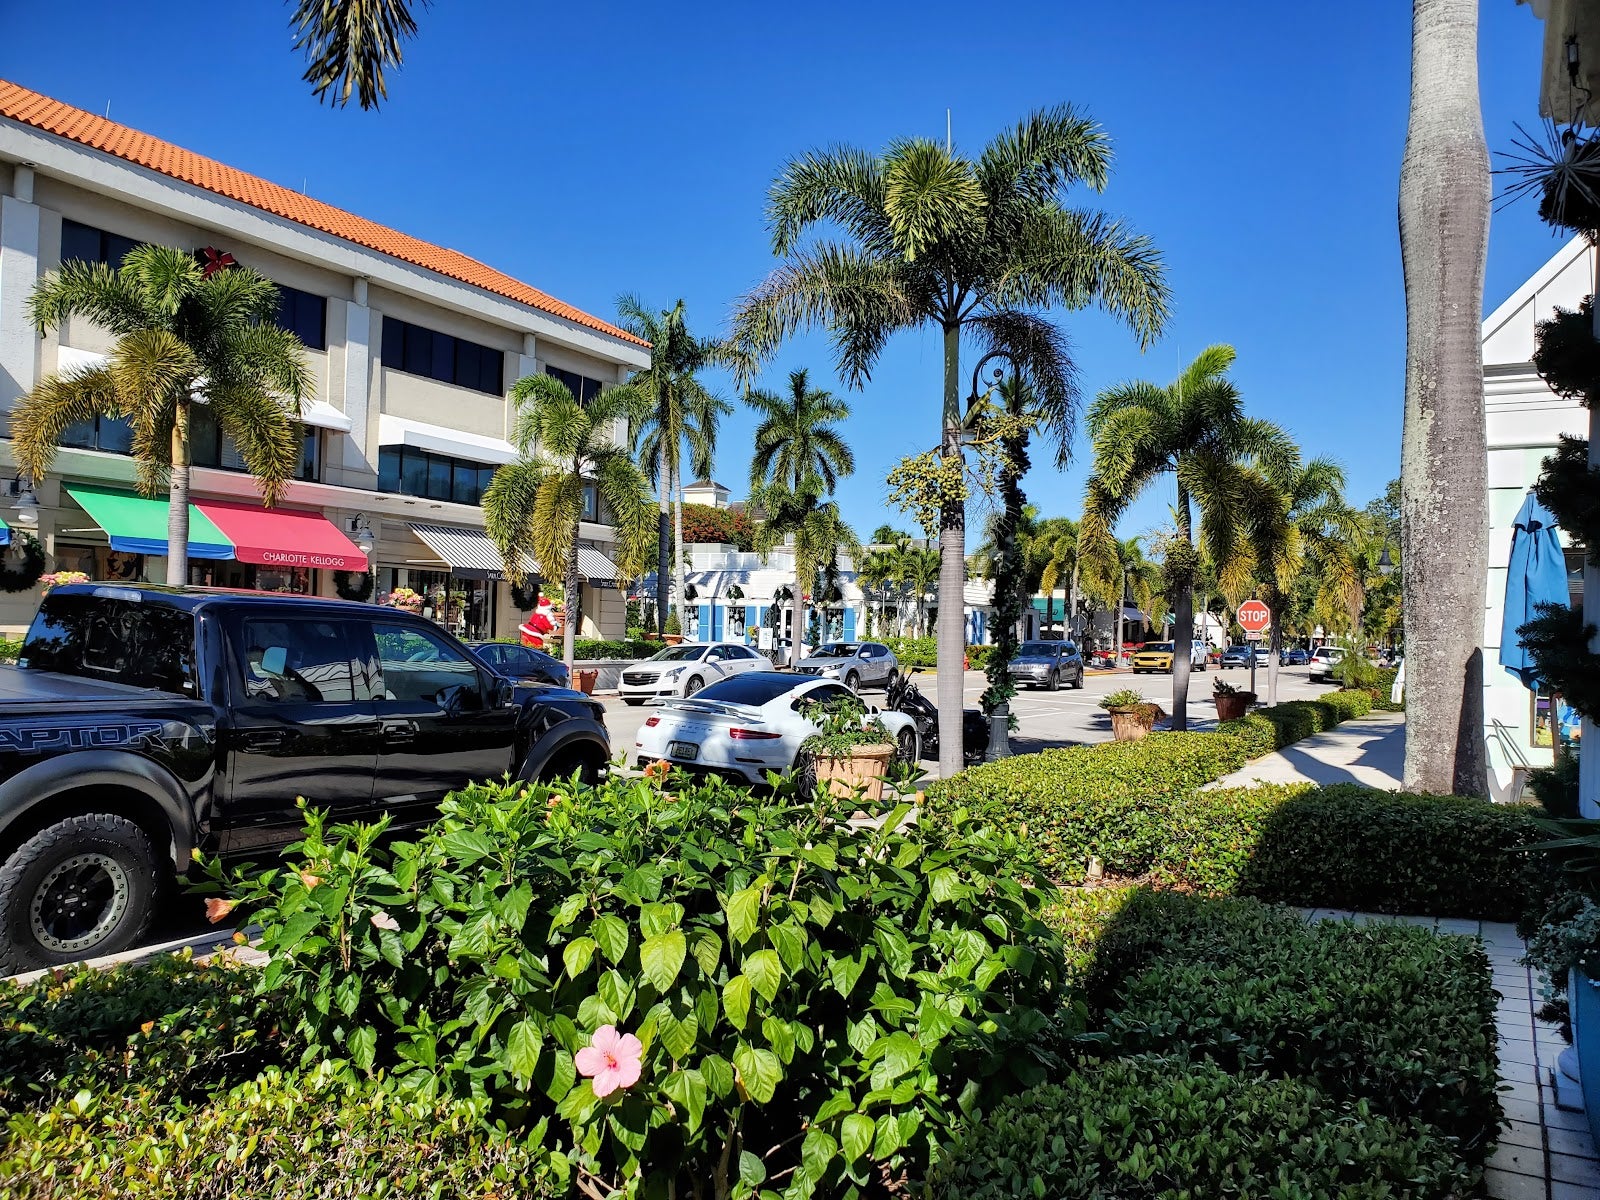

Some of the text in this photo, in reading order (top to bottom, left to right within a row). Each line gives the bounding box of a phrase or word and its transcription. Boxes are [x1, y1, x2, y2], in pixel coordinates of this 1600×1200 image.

[263, 552, 344, 566] CHARLOTTE KELLOGG
[1240, 610, 1267, 622] STOP
